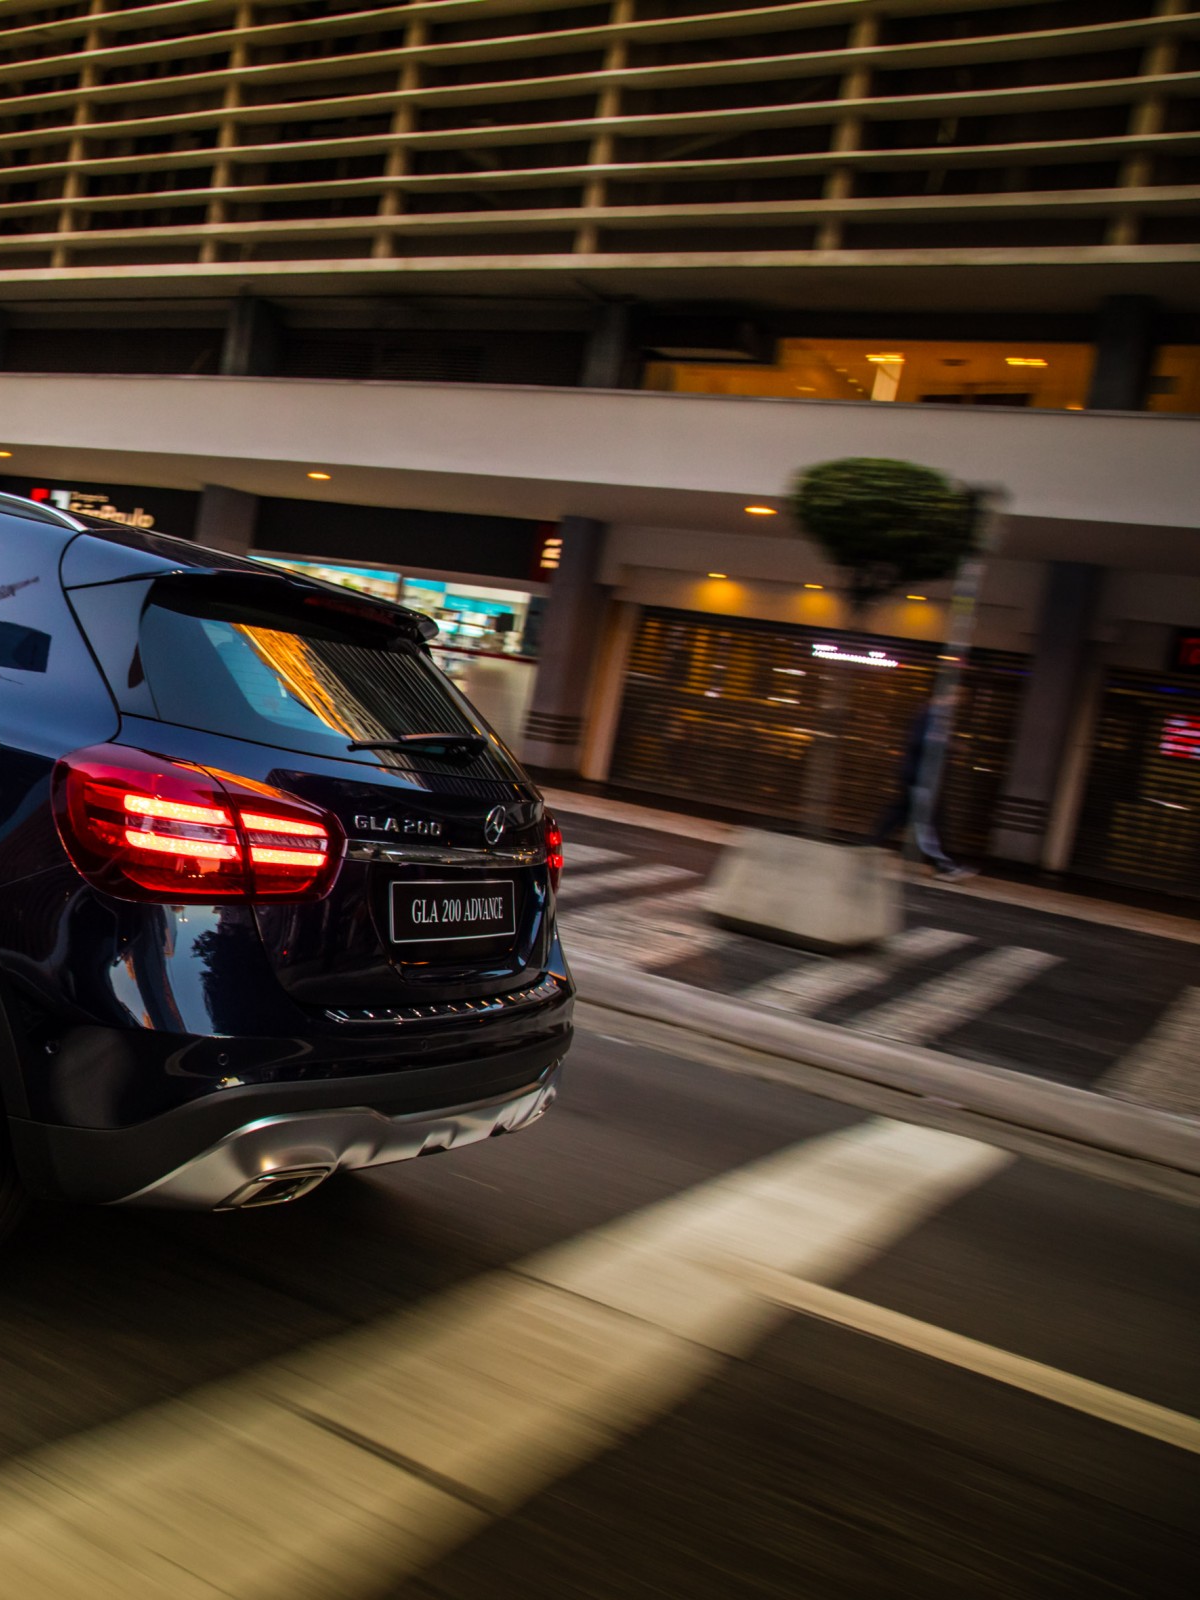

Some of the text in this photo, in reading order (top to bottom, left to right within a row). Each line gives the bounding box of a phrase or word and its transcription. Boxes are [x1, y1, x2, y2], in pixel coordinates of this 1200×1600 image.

[354, 815, 441, 836] GLA 200
[412, 897, 503, 924] GLA 200 ADVANCE
